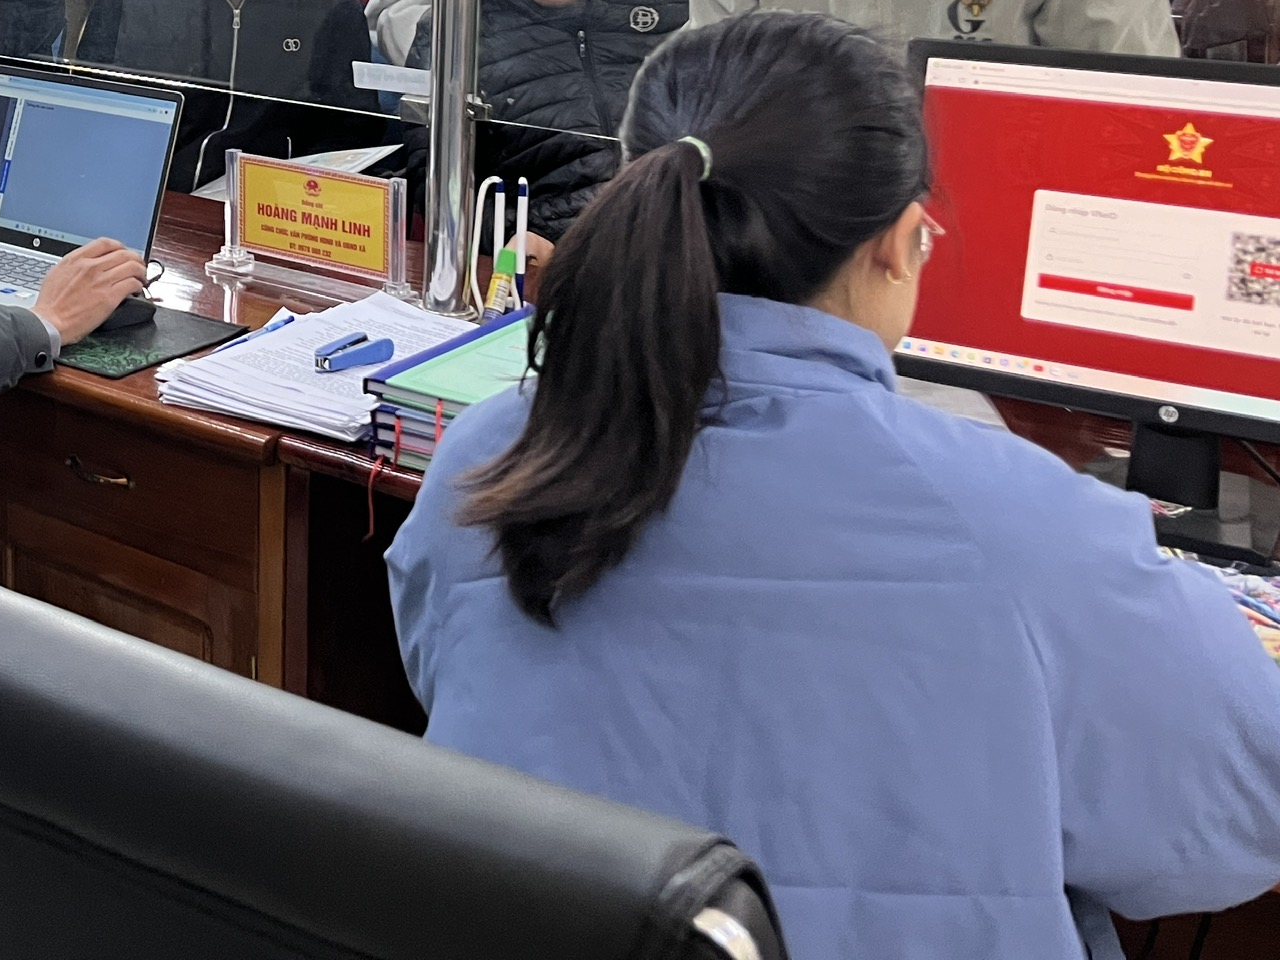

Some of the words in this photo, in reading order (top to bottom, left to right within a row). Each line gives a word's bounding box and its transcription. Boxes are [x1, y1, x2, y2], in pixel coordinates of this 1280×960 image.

[257, 202, 297, 223] HOÀNG
[301, 211, 338, 231] MẠNH
[342, 220, 371, 238] LINH
